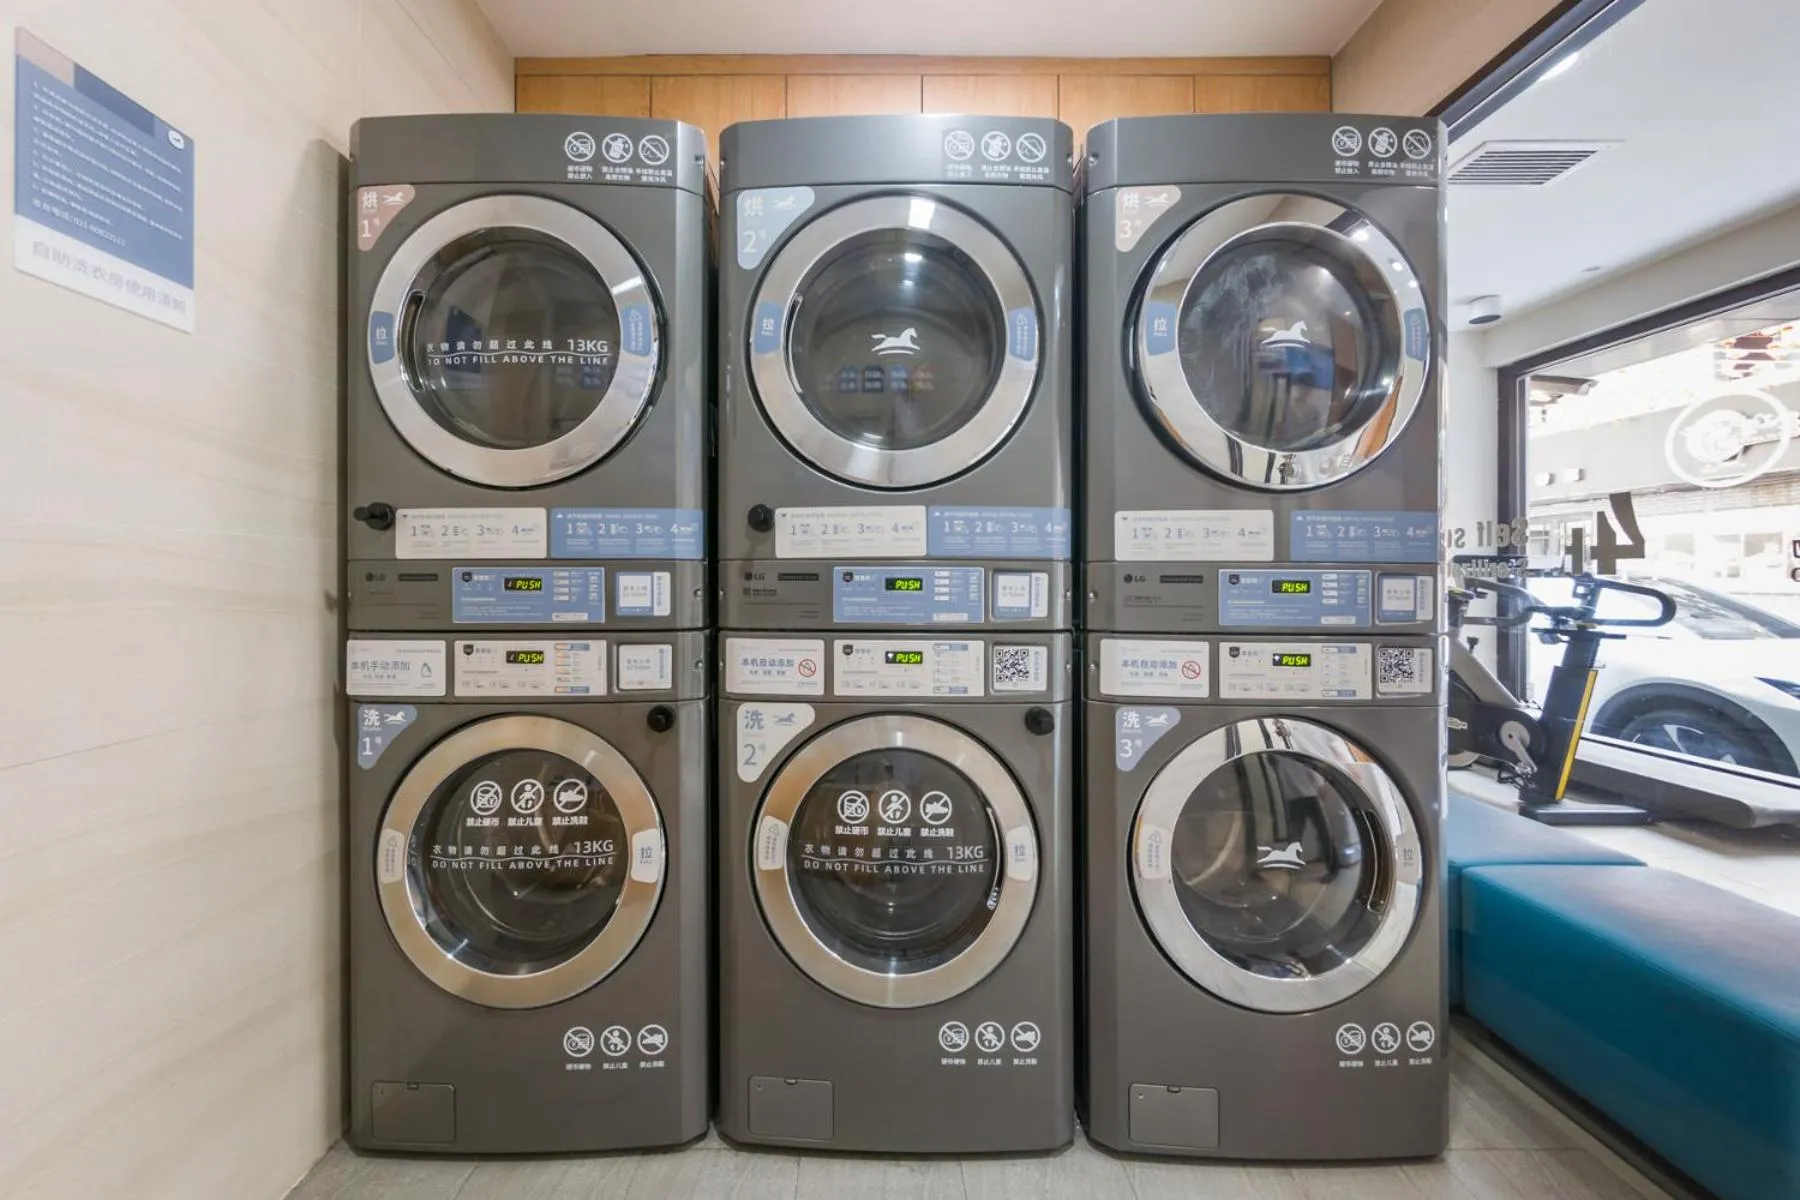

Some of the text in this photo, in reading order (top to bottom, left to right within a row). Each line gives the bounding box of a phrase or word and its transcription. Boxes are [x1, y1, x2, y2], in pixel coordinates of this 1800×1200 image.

[567, 339, 608, 353] 13KG
[446, 356, 468, 365] NOT
[473, 356, 498, 364] FILL
[502, 355, 545, 364] ABOVE
[551, 356, 575, 364] THE
[580, 357, 609, 366] LINE
[516, 580, 541, 590] PUSH
[895, 580, 921, 590] PUSH
[1281, 583, 1308, 593] PUSH
[518, 653, 544, 663] PUSH
[896, 653, 921, 663] PUSH
[1282, 655, 1309, 665] PUSH
[364, 709, 380, 726] 洗
[744, 709, 765, 730] 洗
[1122, 711, 1141, 728] 洗
[877, 827, 912, 837] 禁止儿童
[573, 839, 614, 855] 13KG
[946, 846, 984, 860] 13KG
[432, 856, 614, 870] DO NOT FILL ABOVE THE LINE
[804, 860, 985, 875] DO NOT FILL ABOVE THE LINE
